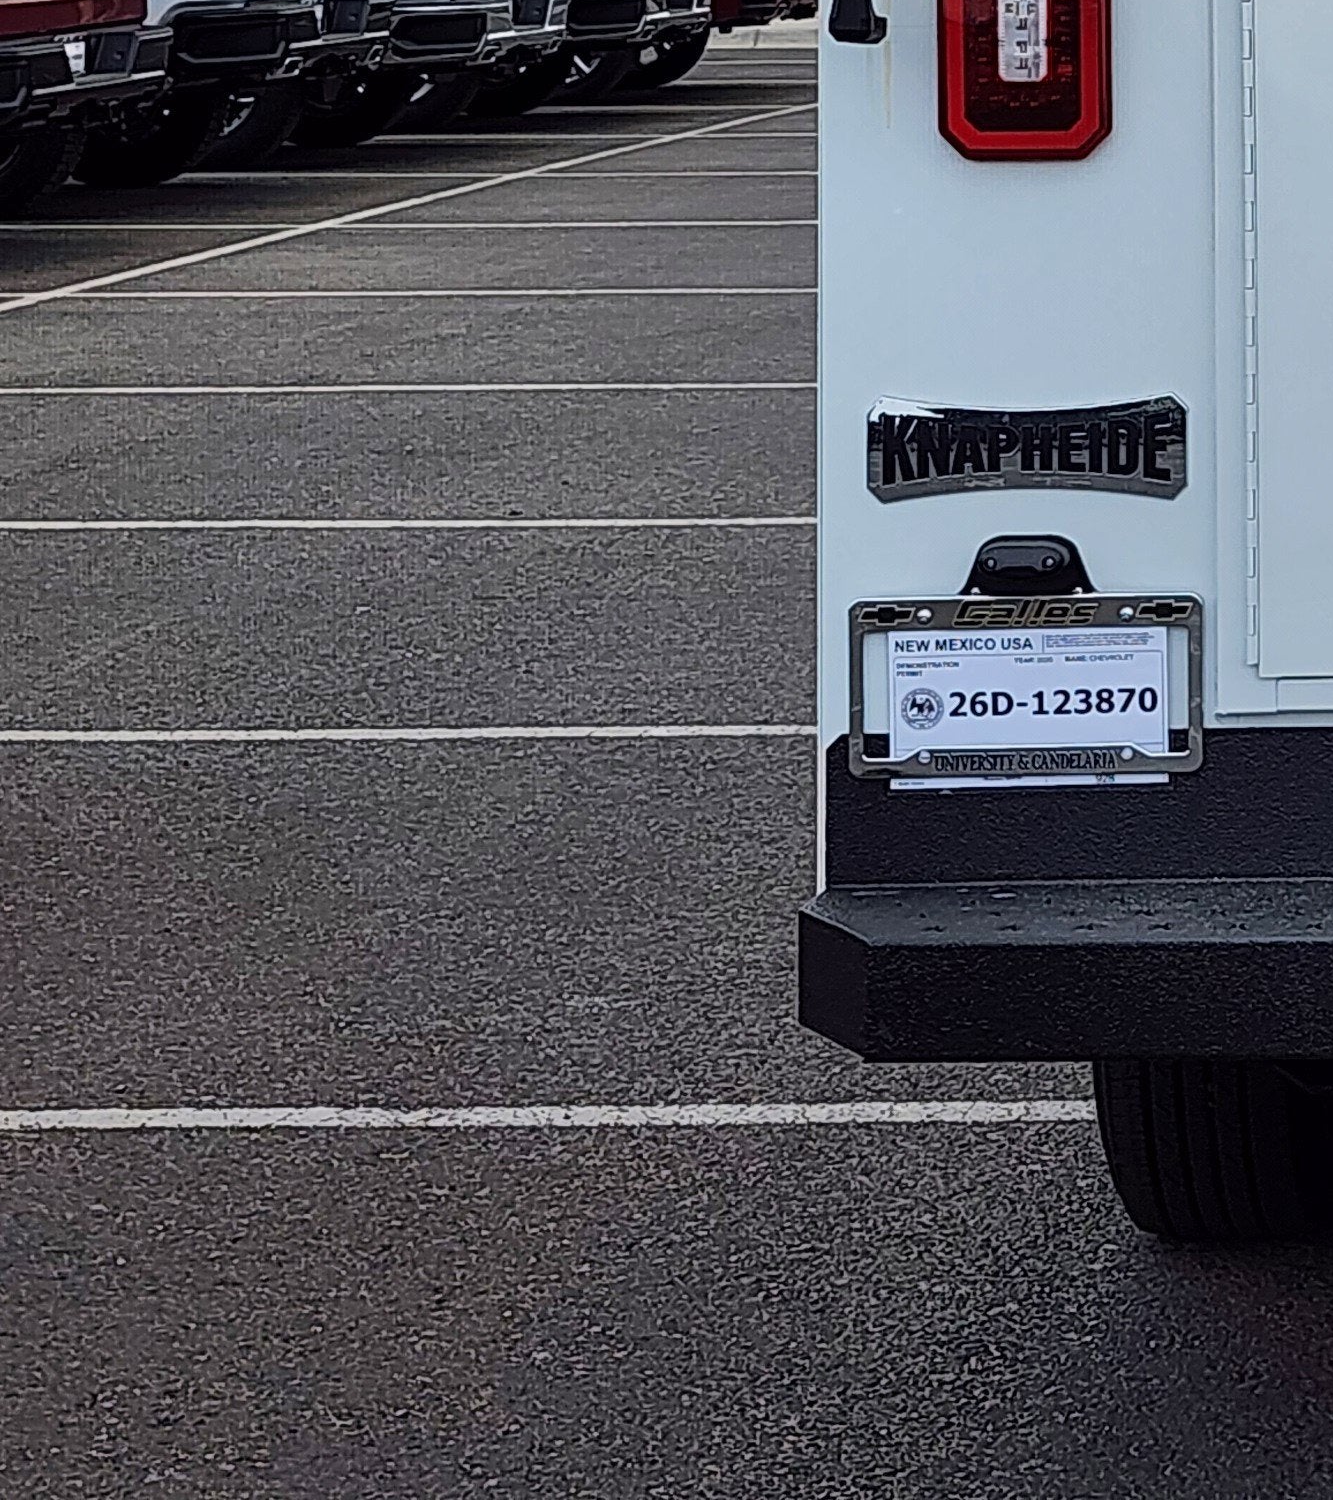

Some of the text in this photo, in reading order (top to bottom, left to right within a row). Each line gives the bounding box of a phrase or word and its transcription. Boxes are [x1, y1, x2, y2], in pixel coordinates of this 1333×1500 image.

[881, 411, 1173, 486] KNAPHEIDE
[954, 599, 1099, 628] Galles
[894, 640, 930, 653] NEW
[935, 639, 995, 652] MEXICO
[1001, 638, 1033, 651] USA
[948, 687, 1158, 718] 26D-123870
[934, 750, 1116, 772] UNIVERSITY & CANDELARIA
